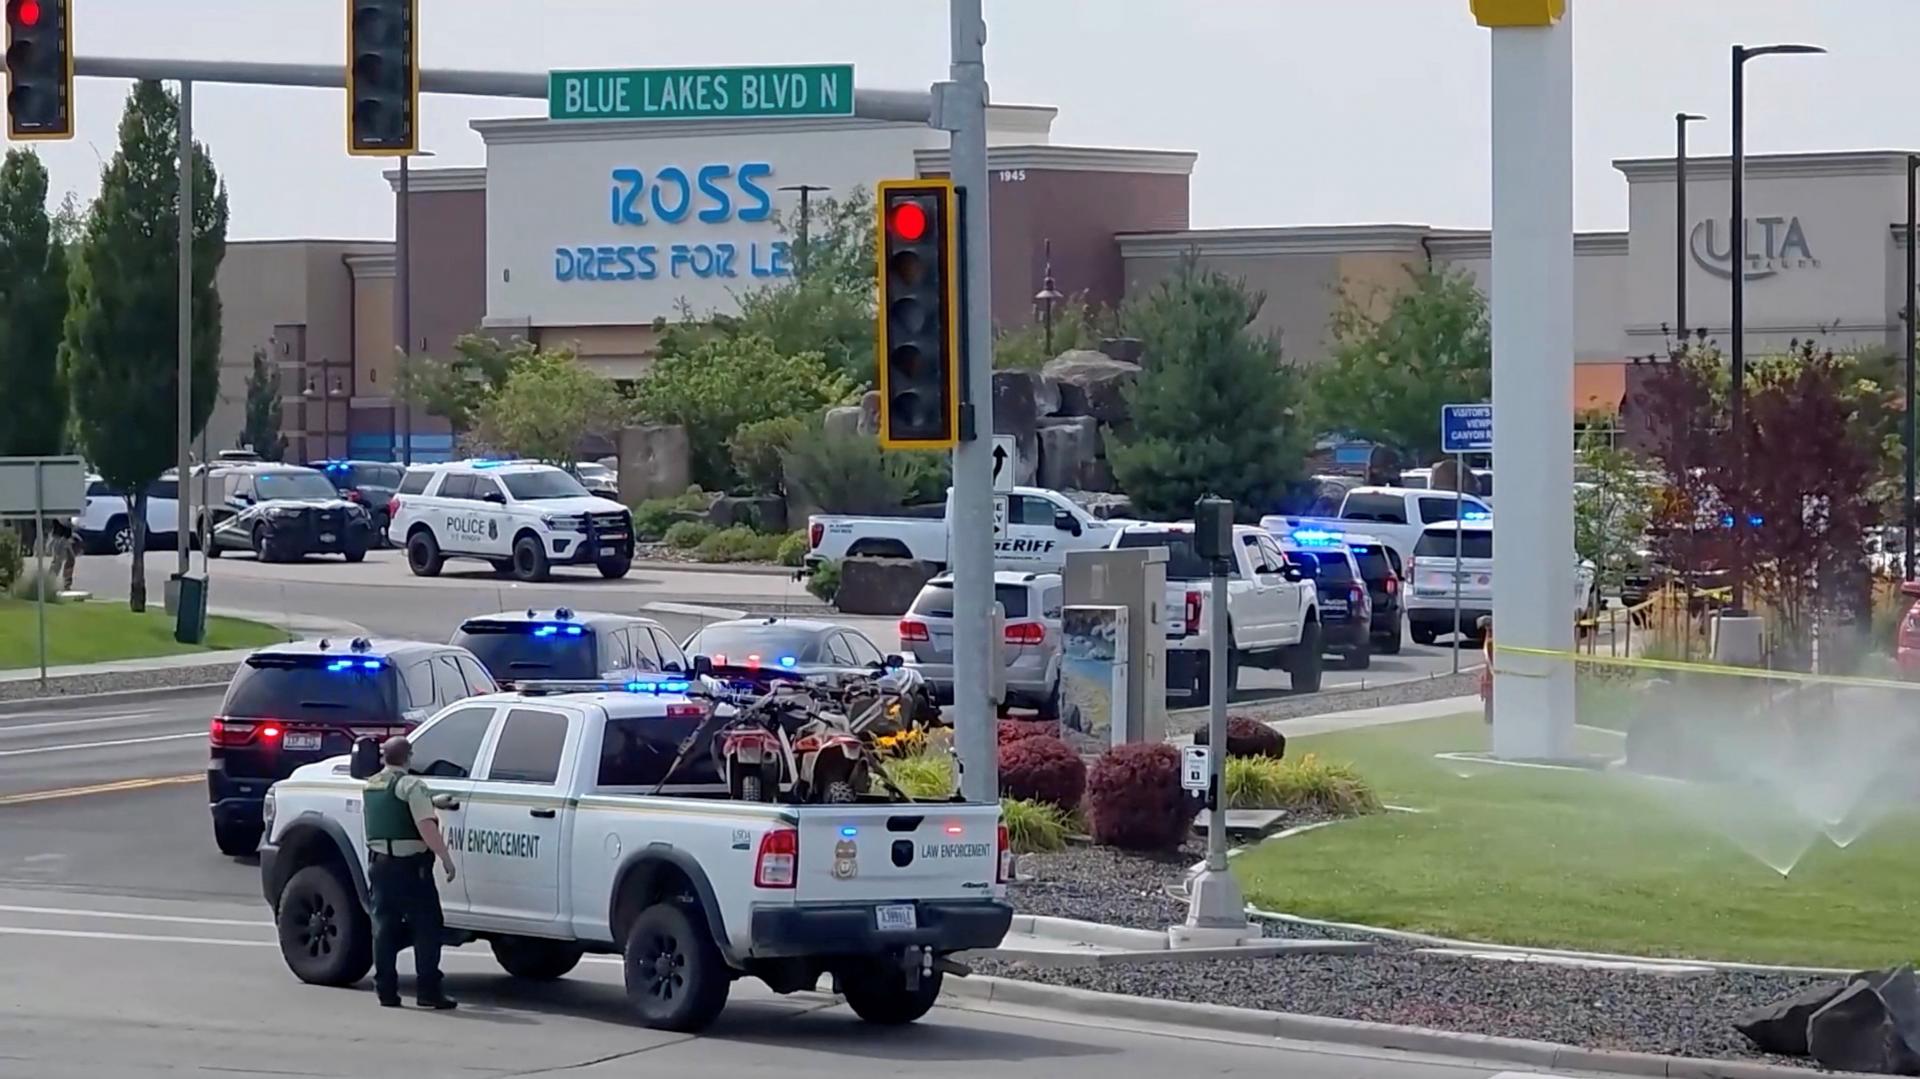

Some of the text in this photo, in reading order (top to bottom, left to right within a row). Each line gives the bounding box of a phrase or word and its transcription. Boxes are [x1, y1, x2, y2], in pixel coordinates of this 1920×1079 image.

[565, 72, 838, 113] BLUE LAKES BLVD N
[999, 170, 1026, 182] 1945
[611, 163, 772, 225] ROSS
[1705, 216, 1813, 261] ULTA
[555, 241, 791, 281] DRESS FOR LE
[1465, 419, 1491, 429] VIEWP
[446, 516, 486, 535] POLICE
[995, 539, 1056, 553] ERIFF
[467, 828, 540, 859] ENFORCEMENT
[921, 843, 991, 859] LAW ENFORCEMENT
